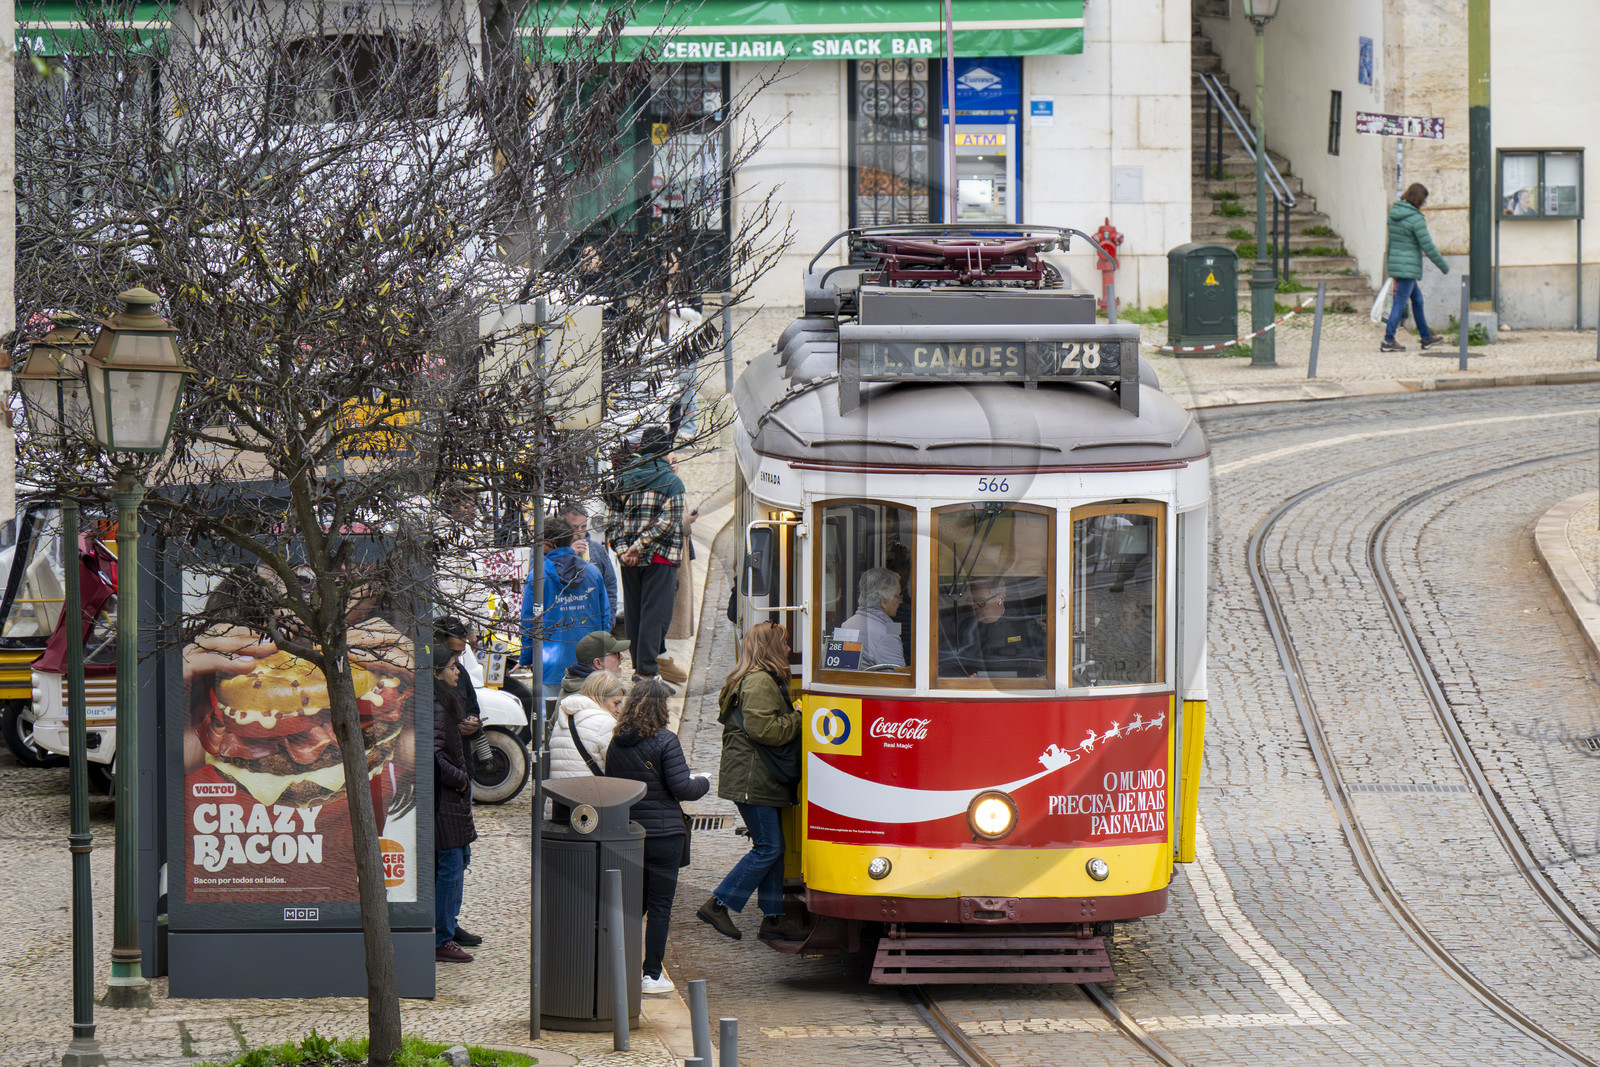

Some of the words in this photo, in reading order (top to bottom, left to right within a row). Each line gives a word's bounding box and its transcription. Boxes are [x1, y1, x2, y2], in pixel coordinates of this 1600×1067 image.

[663, 40, 786, 59] CERVEJARIA
[812, 39, 881, 56] SNACK
[892, 38, 933, 55] BAR
[963, 134, 997, 145] ATM
[884, 347, 903, 368] L.
[1061, 342, 1101, 369] 28
[760, 470, 781, 486] ENTRADA
[978, 477, 1009, 492] 566
[829, 643, 843, 651] 28E
[826, 656, 840, 667] 09
[870, 716, 931, 740] Coca-Cola
[1103, 772, 1118, 792] O
[1120, 768, 1165, 791] MUNDO
[195, 785, 235, 794] VOLTOU
[1048, 793, 1116, 815] PRECISA
[1118, 792, 1136, 812] DE
[1137, 790, 1165, 811] MAIS
[193, 803, 323, 834] CRAZY
[1091, 814, 1121, 835] PAIS
[1123, 811, 1165, 833] NATAIS
[193, 834, 323, 872] BACON
[382, 853, 405, 864] GER
[384, 864, 405, 878] NG
[193, 877, 217, 885] Bacon
[232, 876, 253, 884] todos
[264, 876, 287, 884] lados.
[285, 910, 317, 919] MOP
